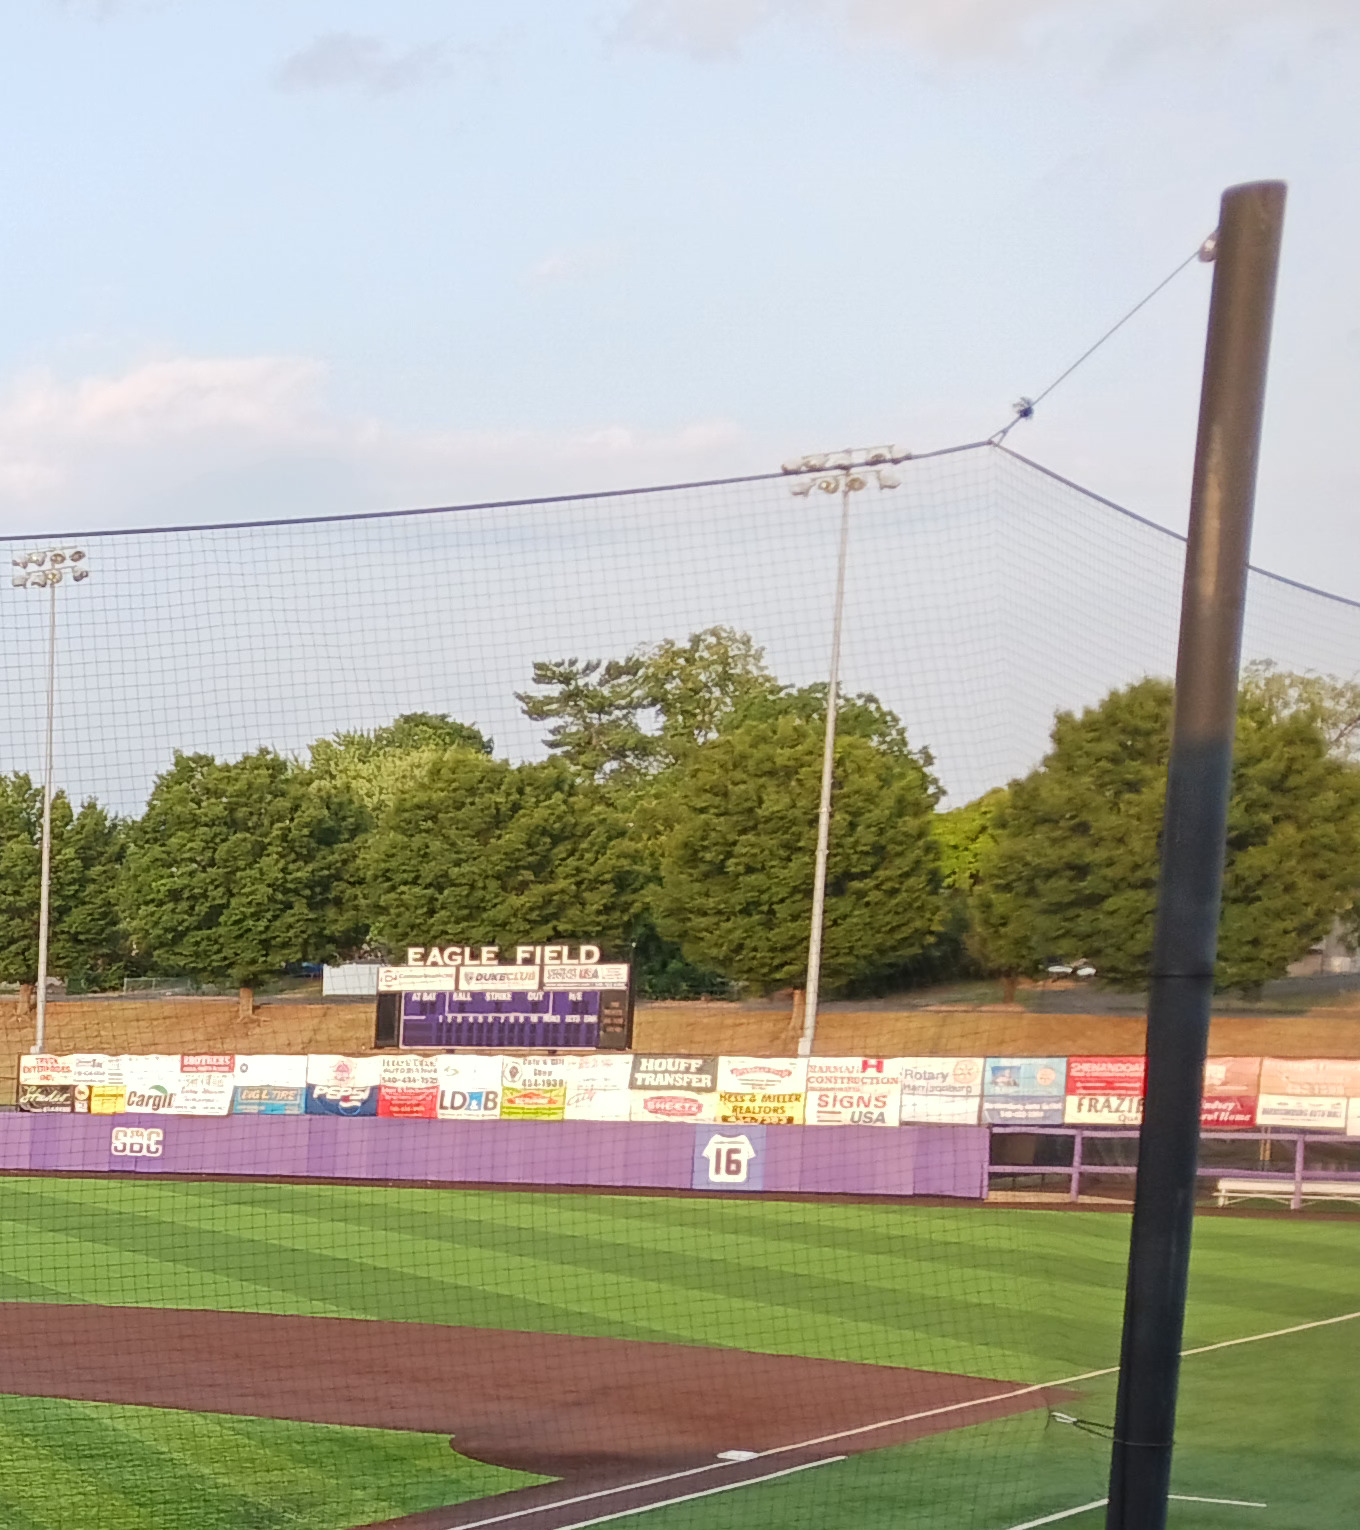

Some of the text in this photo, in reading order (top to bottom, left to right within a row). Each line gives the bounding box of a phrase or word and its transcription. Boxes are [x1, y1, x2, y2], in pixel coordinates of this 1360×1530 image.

[407, 945, 601, 966] EAGLE FIELD
[485, 992, 512, 1001] STRIKE
[527, 991, 544, 1001] OUT
[640, 1058, 703, 1072] HOUFF
[634, 1073, 712, 1089] TRANSFER
[904, 1068, 949, 1083] Rotary
[272, 1091, 295, 1100] TIRE
[313, 1085, 372, 1100] PEPSI
[761, 1093, 802, 1103] MILLER
[439, 1090, 499, 1111] LD&B
[817, 1094, 888, 1109] SIGNS
[1077, 1097, 1145, 1114] FRAZIE
[732, 1105, 786, 1115] REALTORS
[850, 1111, 886, 1124] USA
[714, 1147, 742, 1176] 16
